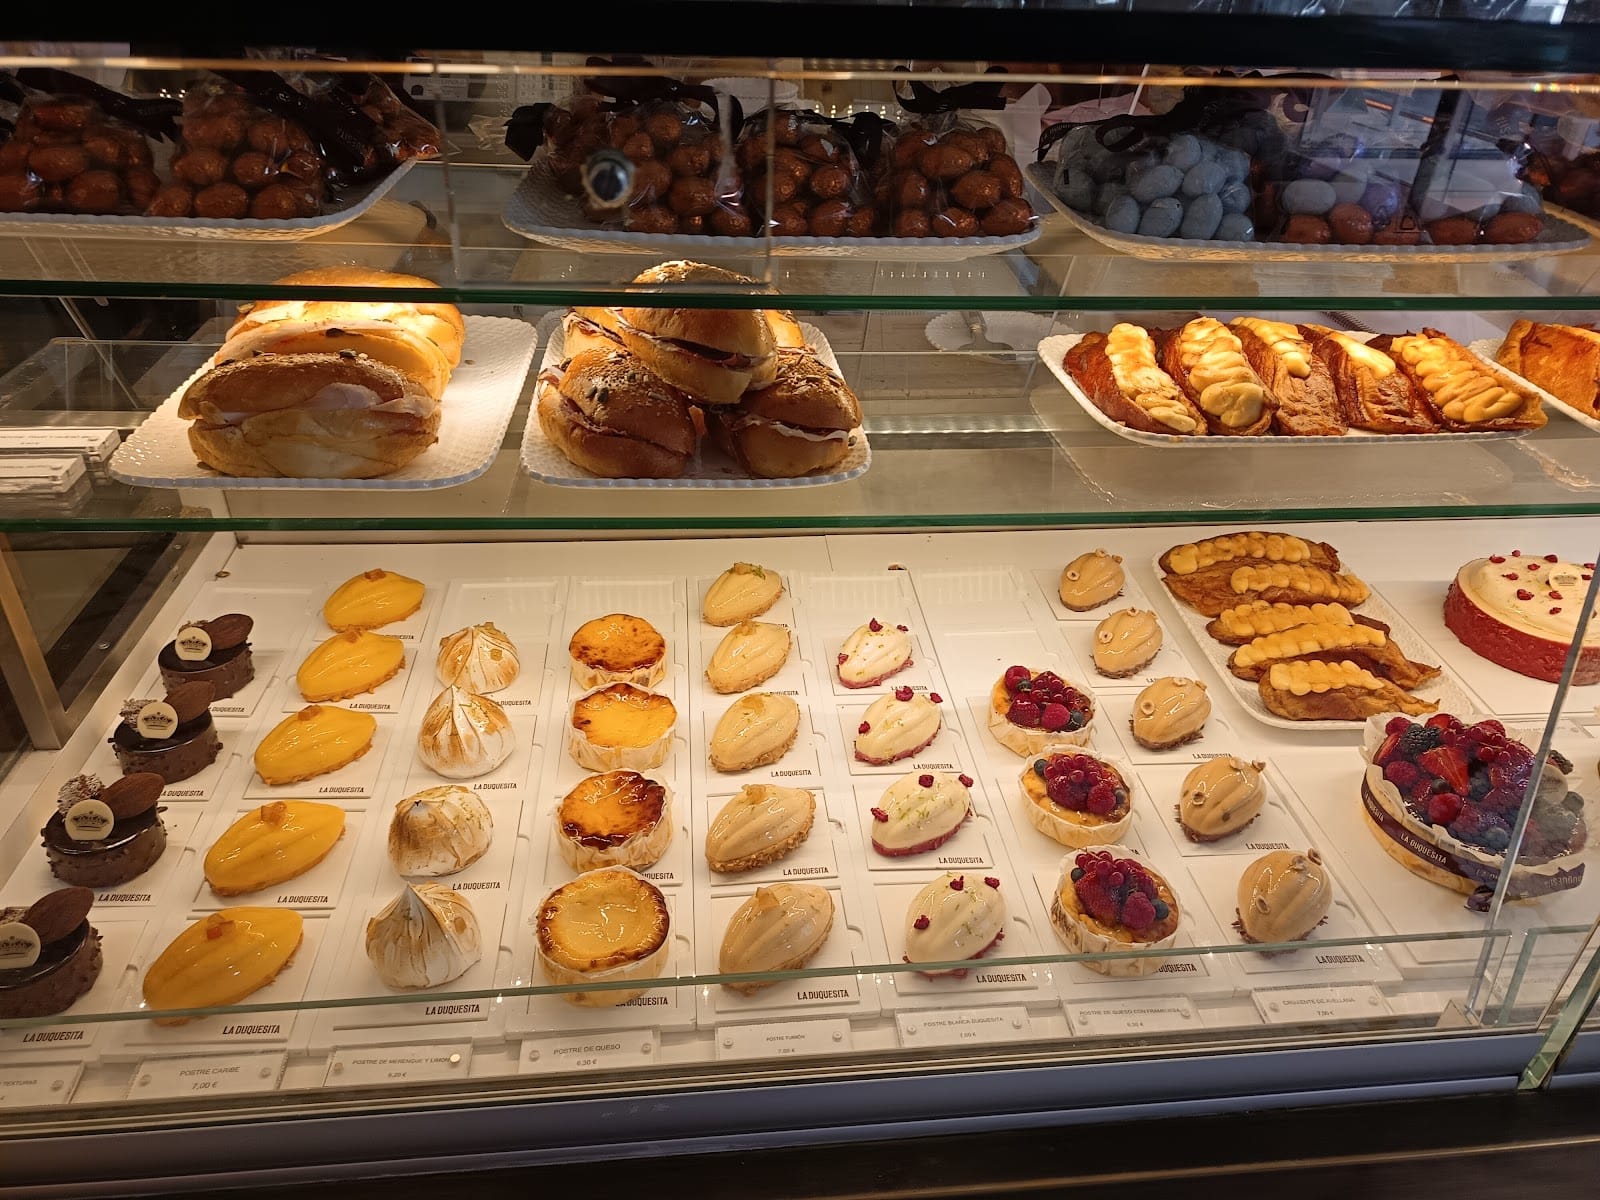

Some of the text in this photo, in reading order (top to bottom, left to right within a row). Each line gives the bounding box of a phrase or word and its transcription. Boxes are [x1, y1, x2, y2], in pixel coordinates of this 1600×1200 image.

[779, 769, 812, 777] DUQUESITA
[329, 786, 365, 794] DUQUESITA
[483, 782, 517, 790] DUQUESITA
[1245, 842, 1291, 850] LA DUQUESITA
[1400, 833, 1447, 865] LA DUQUESITA
[783, 867, 829, 876] LA DUQUESITA
[452, 881, 501, 891] LA DUQUESITA
[98, 894, 152, 902] LA DUQUESITA
[277, 895, 329, 903] LA DUQUESITA
[1315, 954, 1365, 964] LA DUQUESITA
[976, 973, 1028, 983] LA DUQUESITA
[797, 989, 850, 1001] LA DUQUESITA
[425, 1004, 480, 1016] LA DUQUESITA
[923, 1020, 947, 1028] POSTRE
[222, 1024, 281, 1035] LA DUQUESITA
[22, 1030, 84, 1043] LA DUQUESITA
[553, 1047, 584, 1055] POSTRE
[595, 1043, 621, 1051] QUESO
[179, 1066, 241, 1077] POSTRE CARIBE
[191, 1081, 219, 1090] 7,00 €
